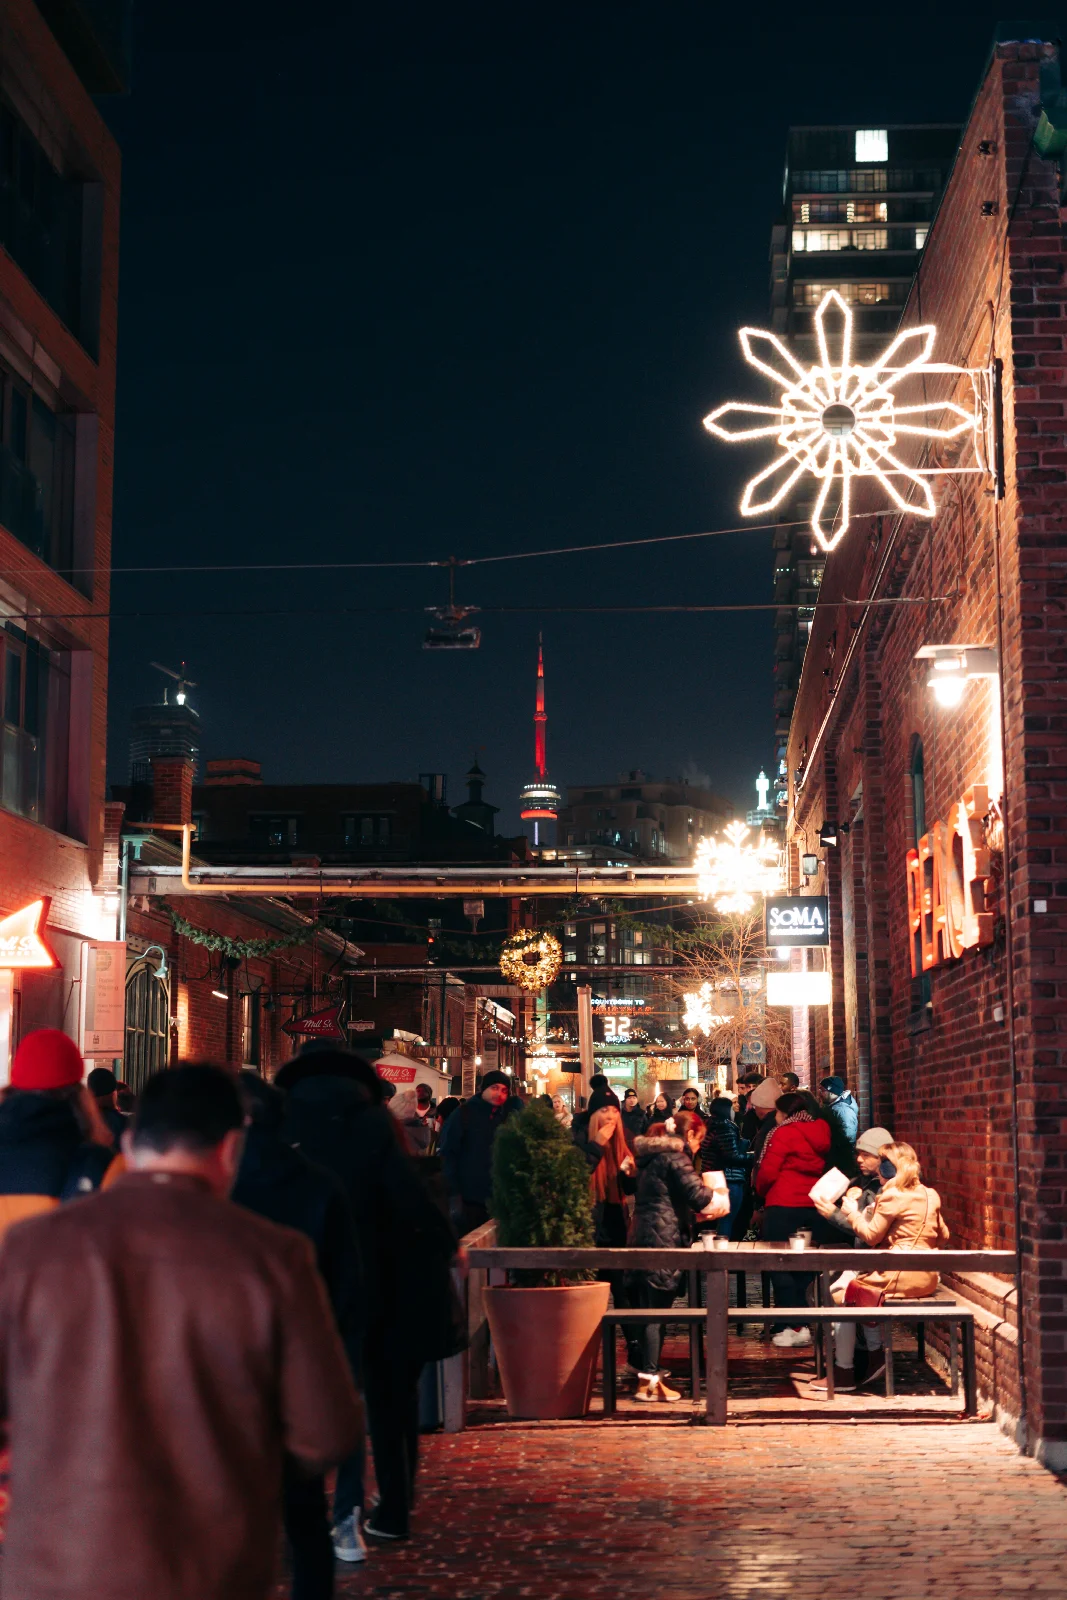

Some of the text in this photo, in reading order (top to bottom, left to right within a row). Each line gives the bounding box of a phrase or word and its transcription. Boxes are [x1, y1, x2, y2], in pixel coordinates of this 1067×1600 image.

[906, 784, 994, 978] PEACE
[769, 906, 824, 927] SOMA
[302, 1019, 322, 1028] Mill
[604, 1016, 630, 1036] 32
[379, 1067, 412, 1078] Mill St.
